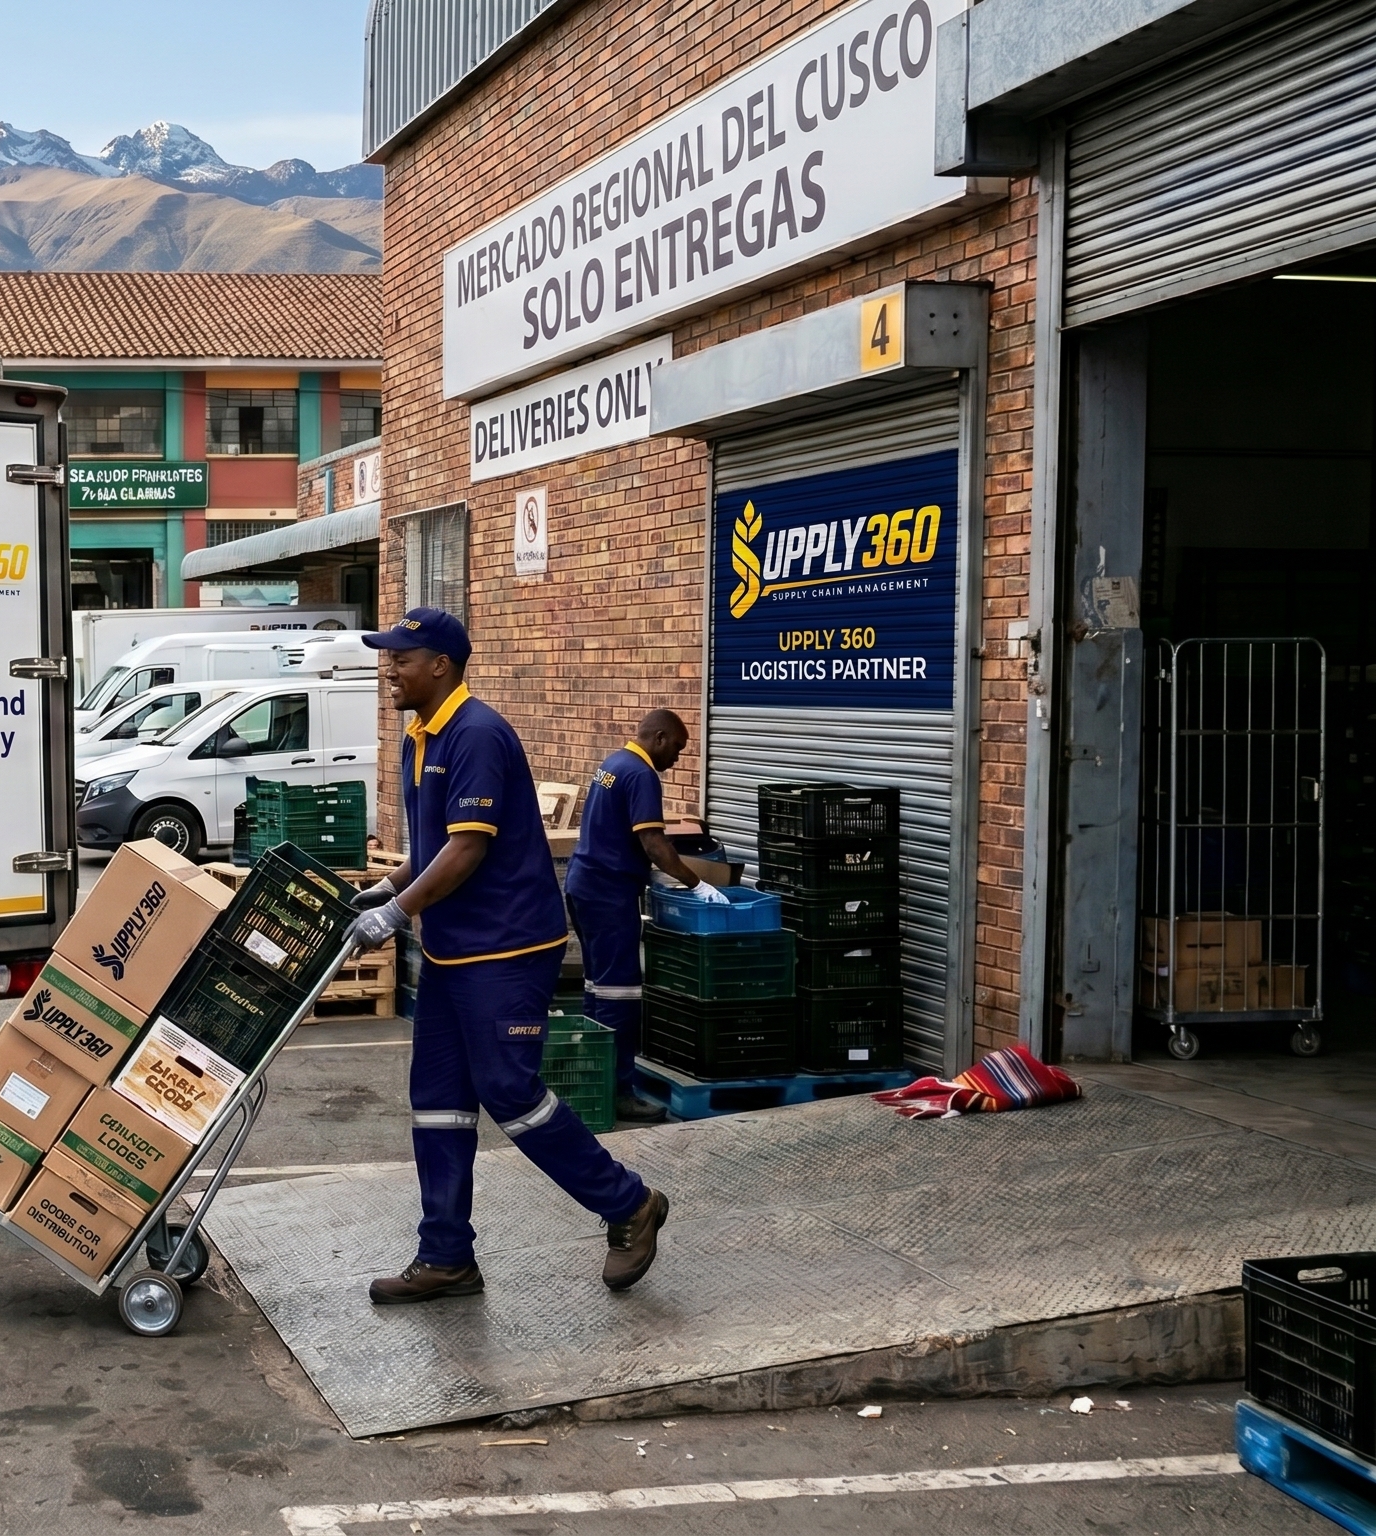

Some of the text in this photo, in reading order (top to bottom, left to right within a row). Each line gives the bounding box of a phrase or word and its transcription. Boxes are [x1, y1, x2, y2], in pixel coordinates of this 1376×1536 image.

[457, 0, 933, 308] MERCADO REGIONAL DEL CUSCO
[523, 150, 826, 350] SOLO ENTREGAS
[871, 303, 890, 356] 4
[475, 384, 590, 464] DELIVERIES
[772, 578, 929, 601] SUPPLY CHAIN MANAGEMENT
[779, 626, 876, 652] UPPLY 360
[741, 656, 927, 681] LOGISTICS PARTNER
[26, 1205, 99, 1261] DISTRIBUTION
